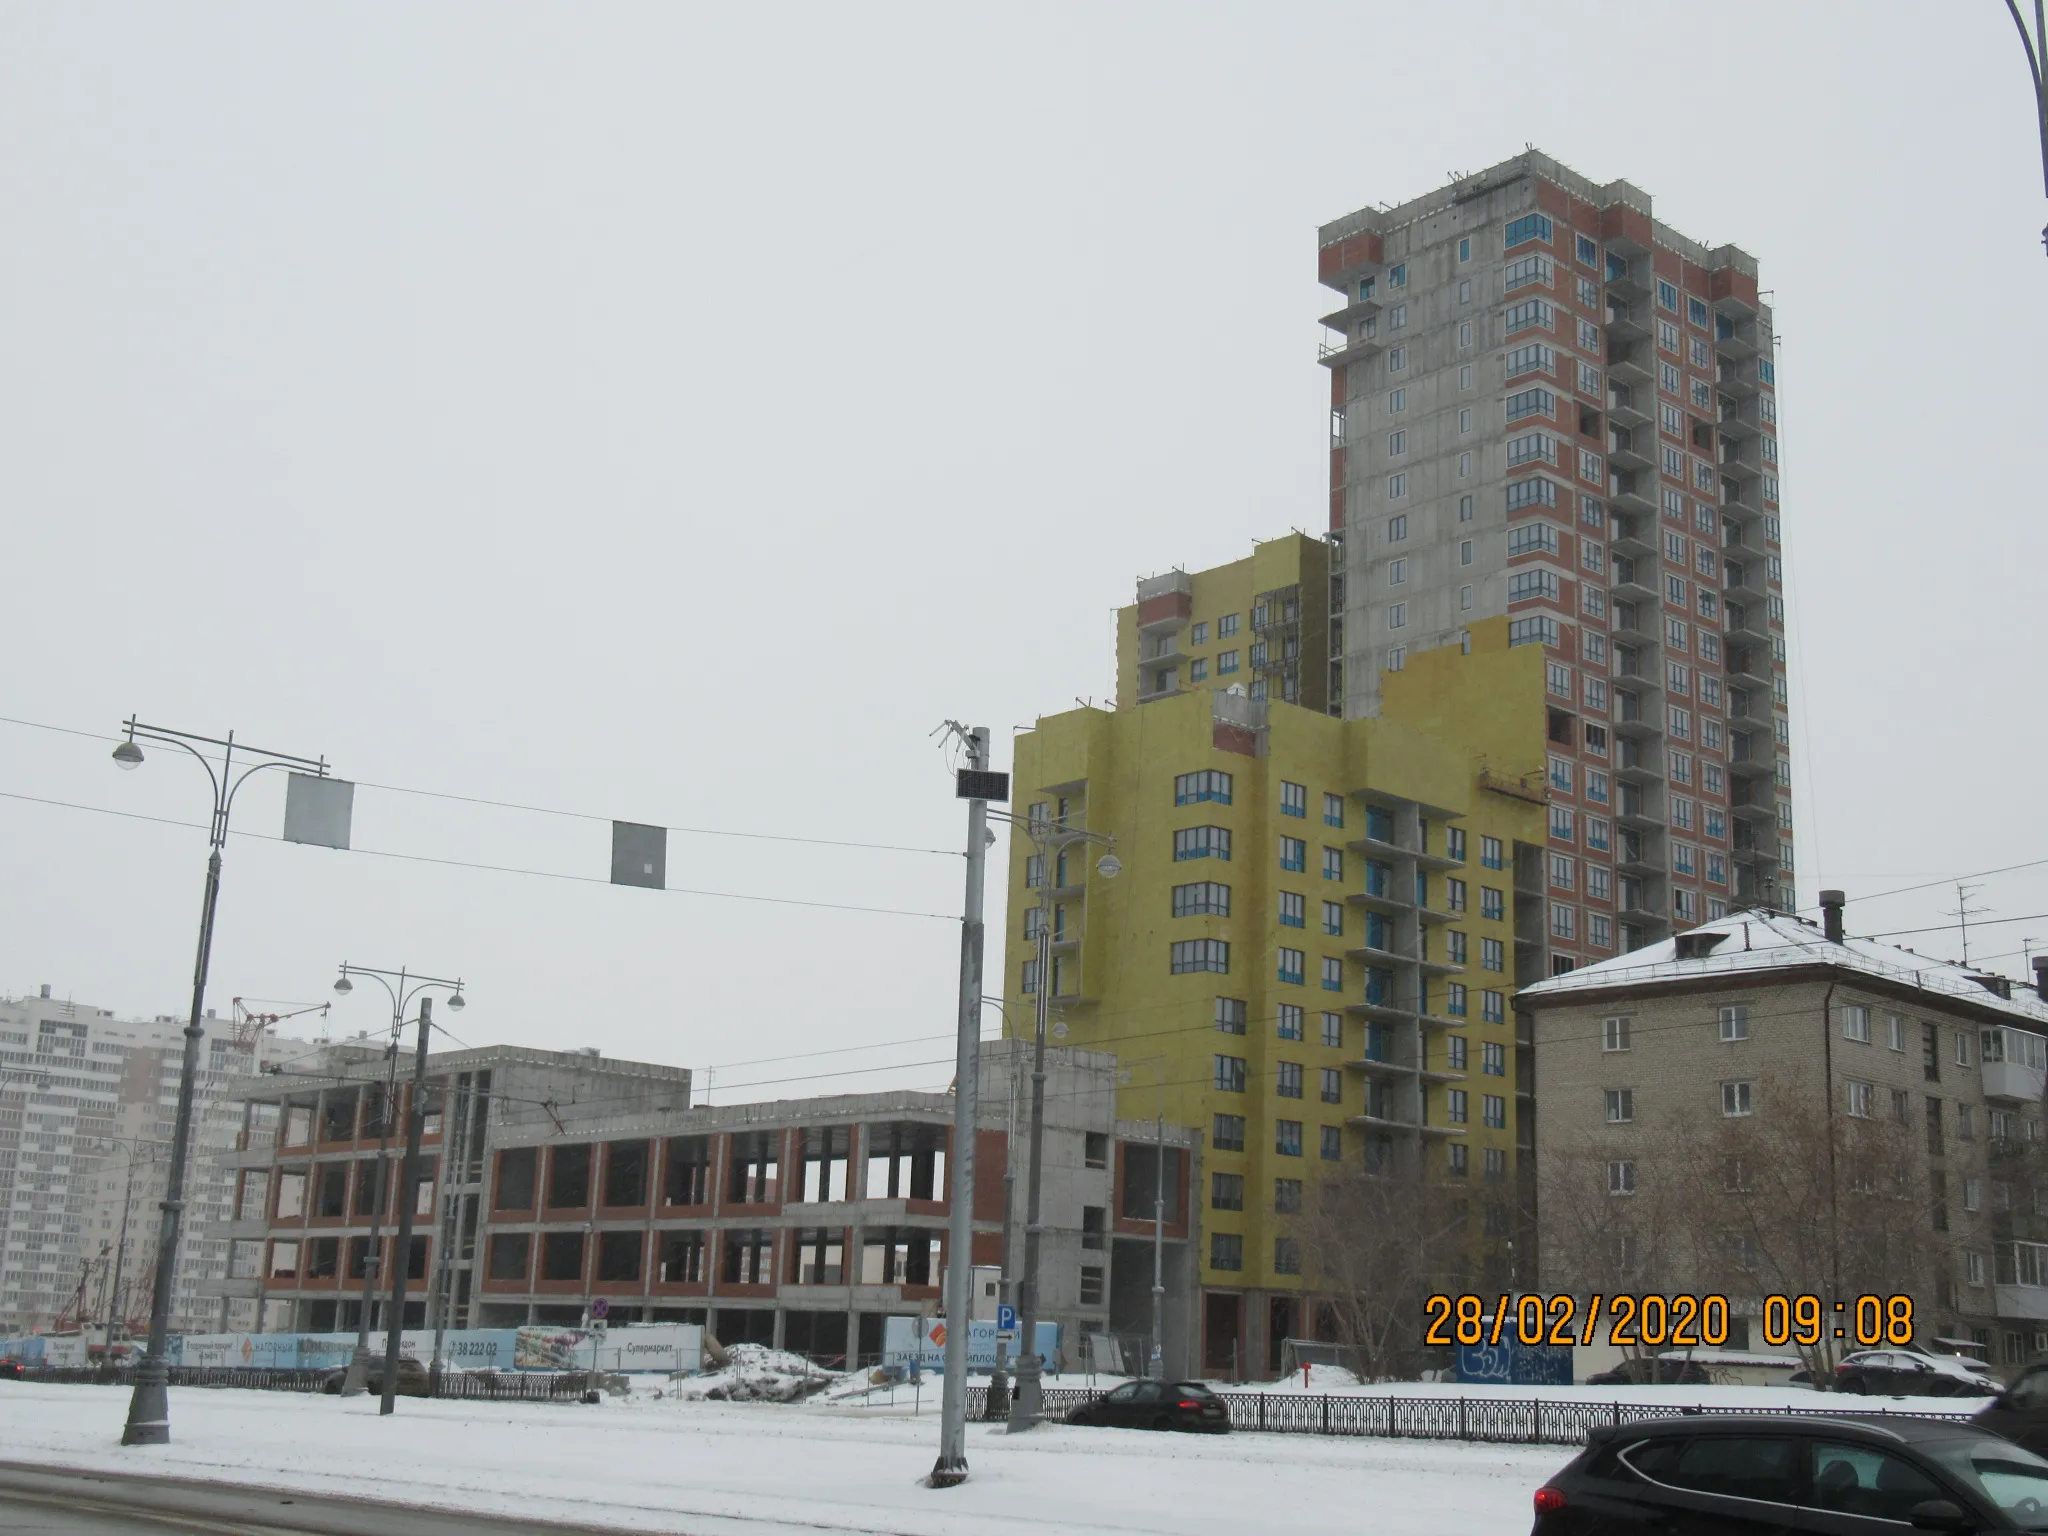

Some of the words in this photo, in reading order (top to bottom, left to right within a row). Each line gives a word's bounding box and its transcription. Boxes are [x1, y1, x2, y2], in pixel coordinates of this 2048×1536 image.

[1001, 1307, 1012, 1328] P
[255, 1340, 293, 1352] НАГОРНЫЙ
[457, 1342, 468, 1356] 38
[469, 1342, 485, 1356] 222
[485, 1342, 498, 1356] 02
[627, 1342, 672, 1355] Супермаркет
[926, 1353, 940, 1361] НА
